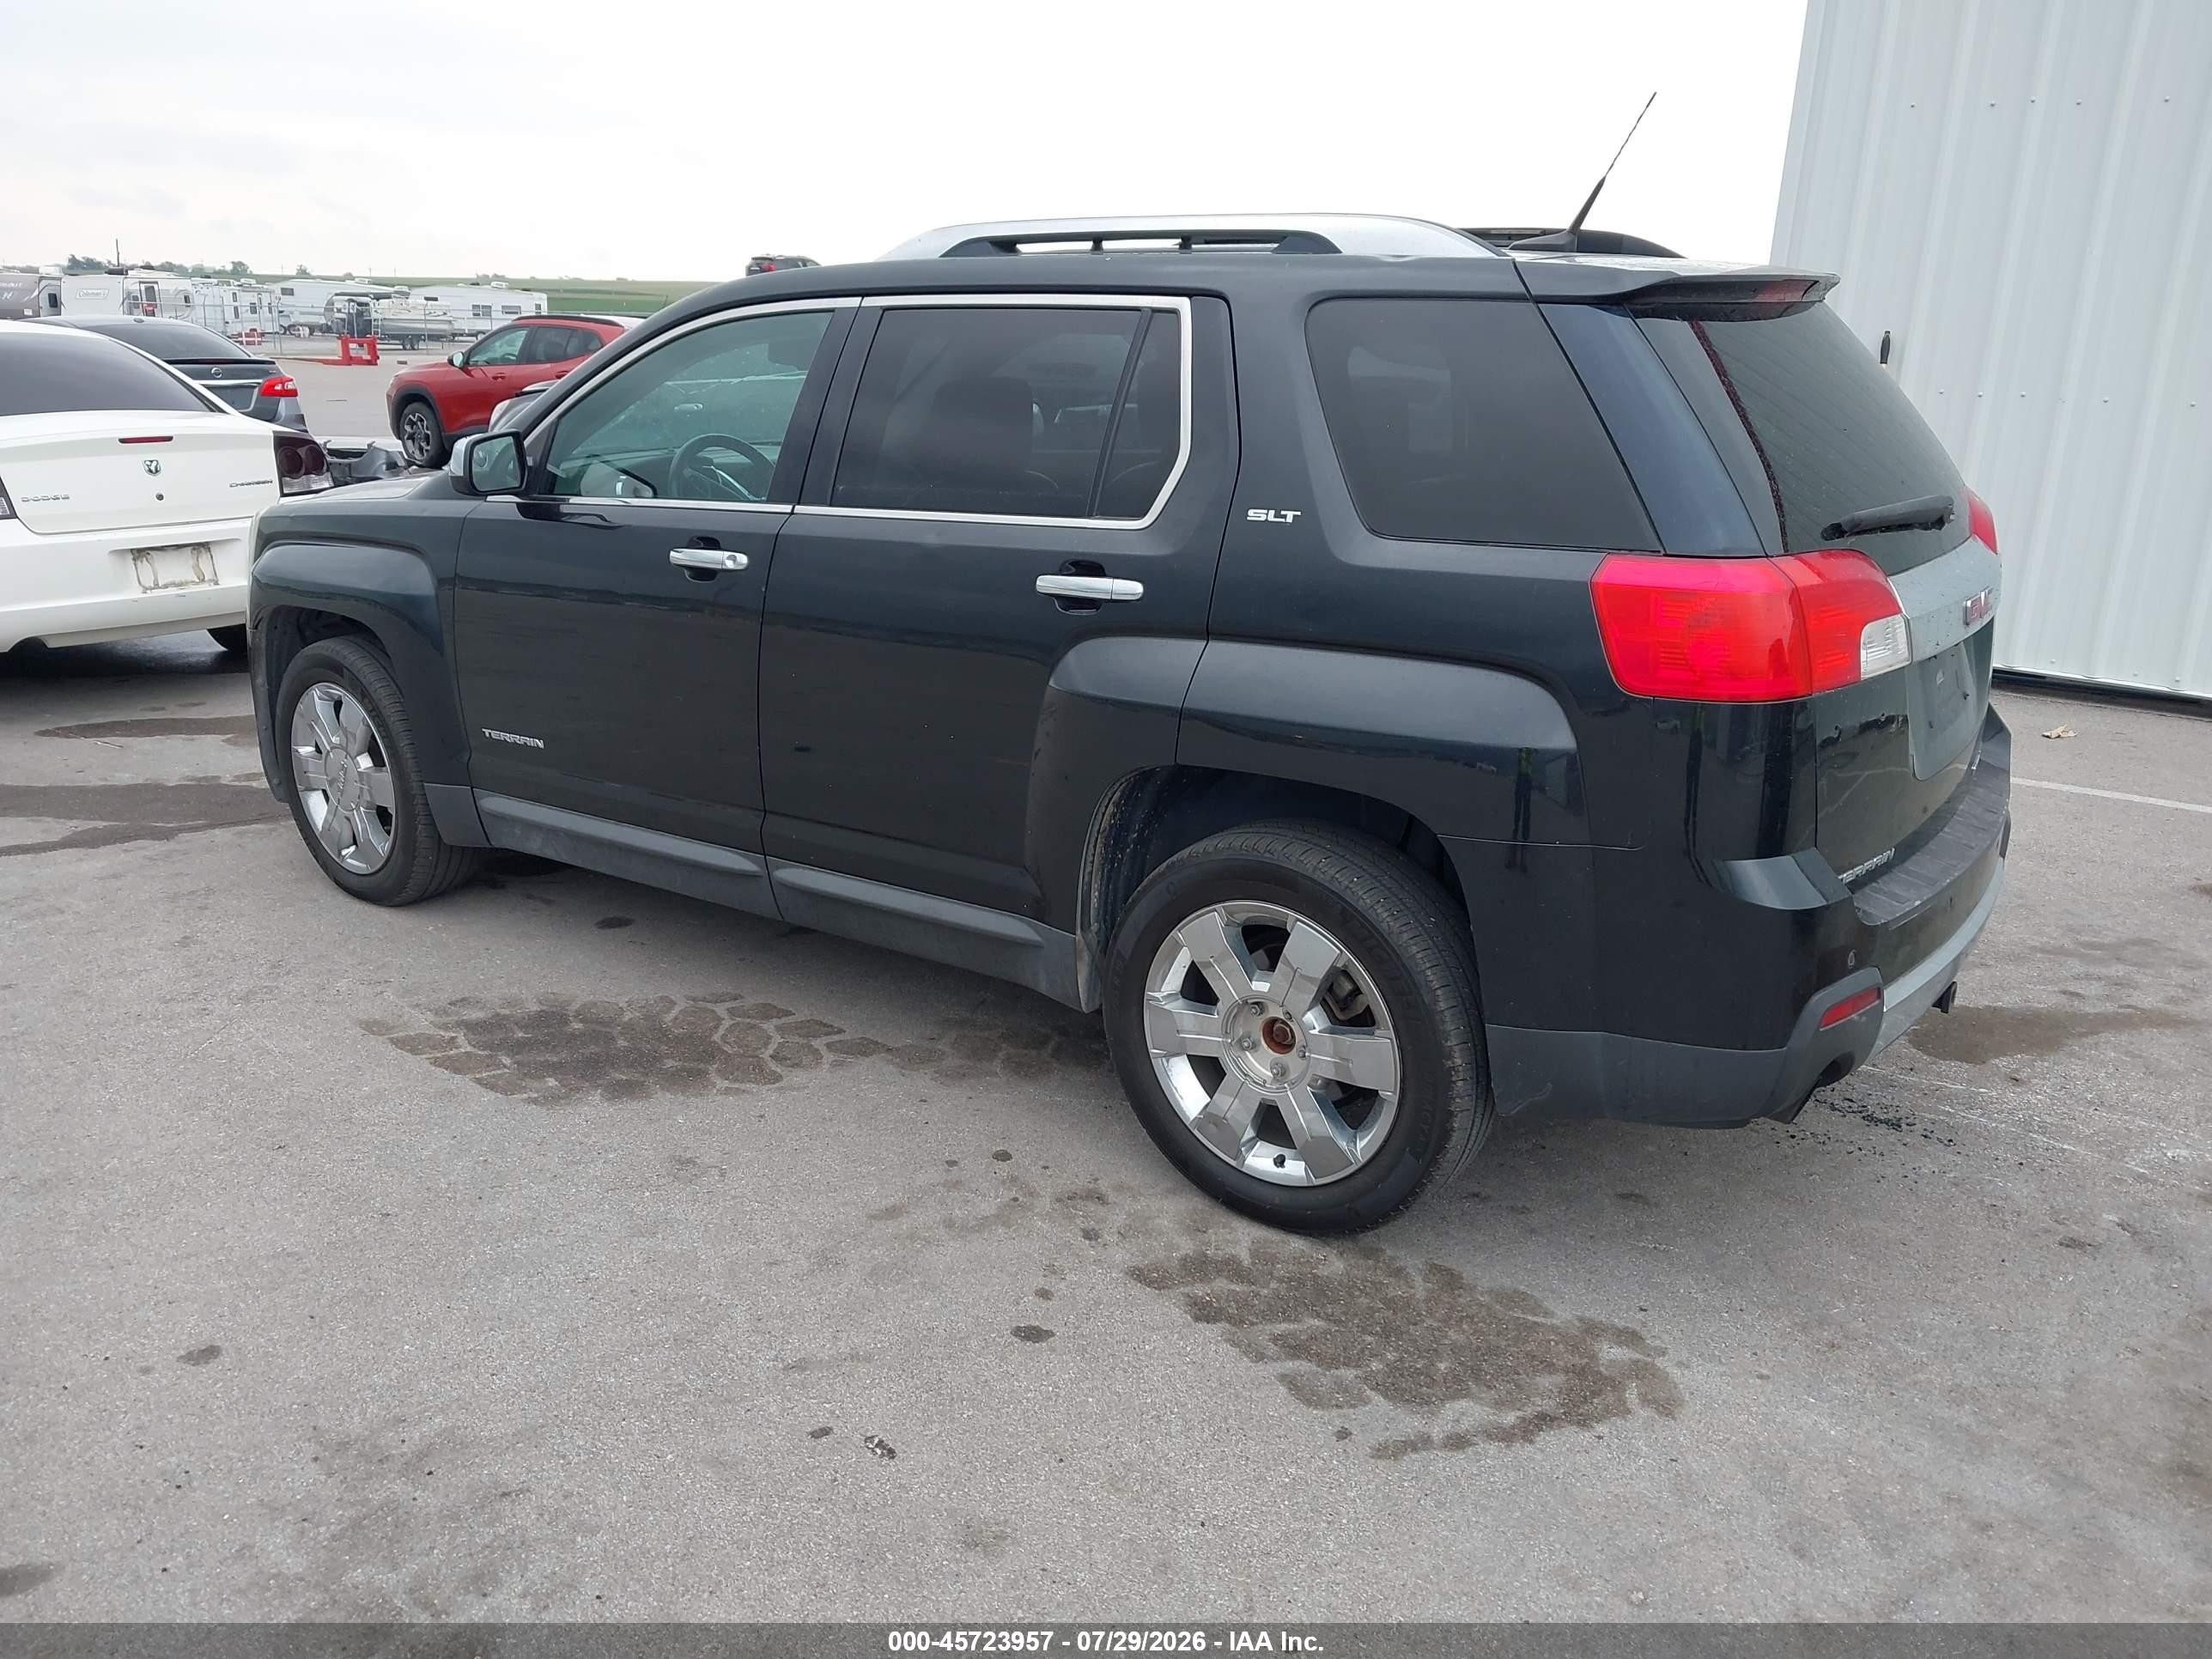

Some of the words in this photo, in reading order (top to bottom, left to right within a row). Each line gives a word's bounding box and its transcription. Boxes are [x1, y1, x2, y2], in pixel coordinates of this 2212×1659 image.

[21, 494, 70, 502] DODGE
[1246, 508, 1302, 523] SLT
[481, 728, 544, 749] TERRAIN
